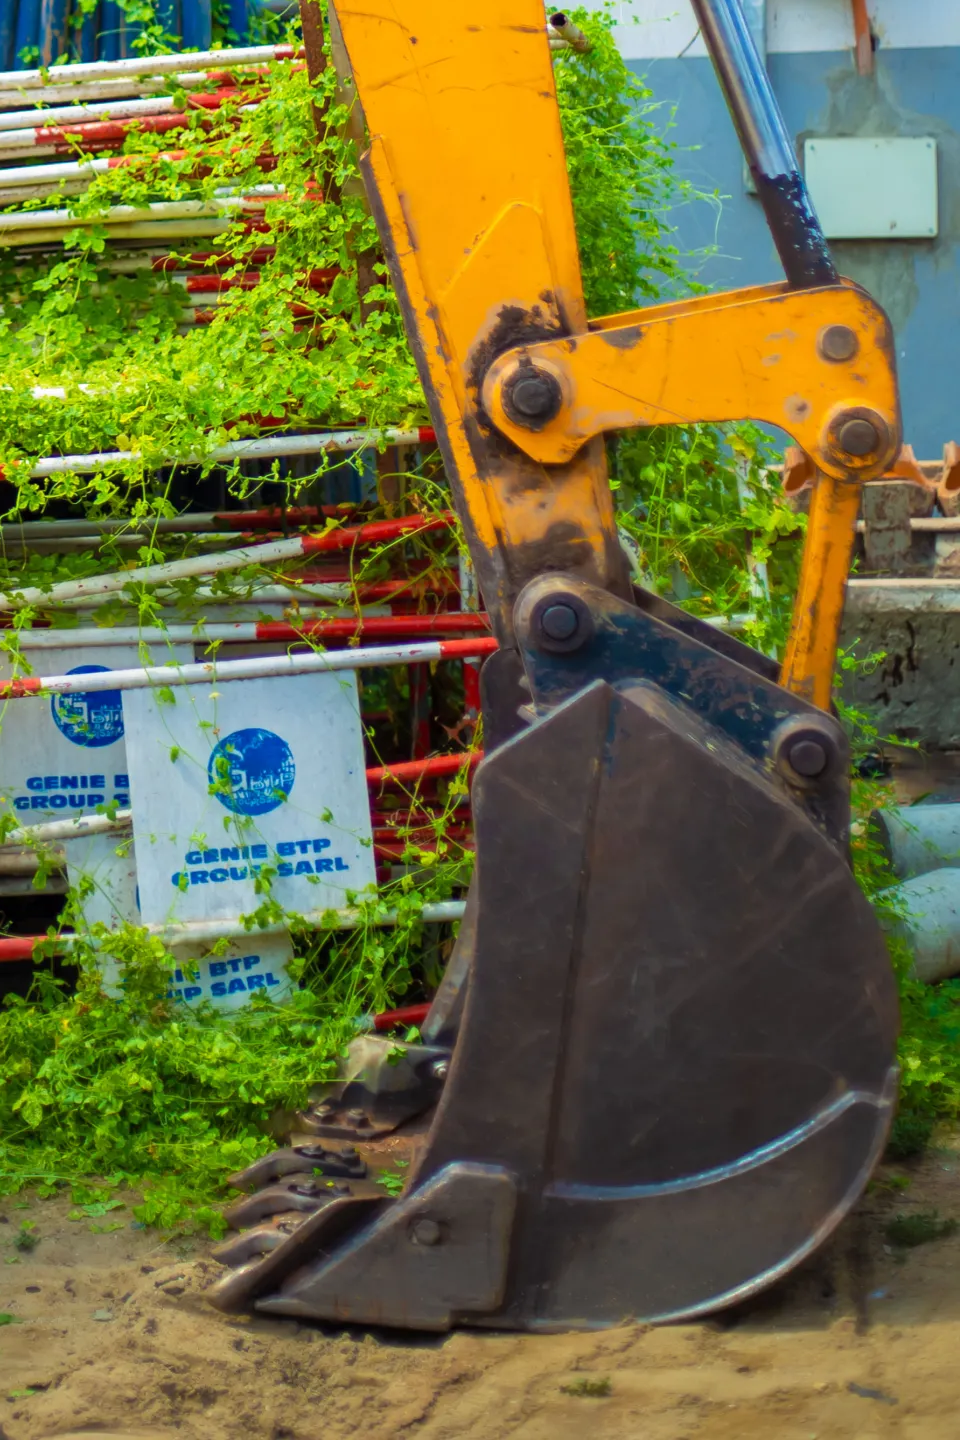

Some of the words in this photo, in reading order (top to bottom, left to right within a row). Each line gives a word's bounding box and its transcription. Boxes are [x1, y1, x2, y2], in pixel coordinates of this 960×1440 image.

[26, 774, 105, 790] GENIE
[13, 793, 105, 810] GROUP
[185, 844, 267, 865] GENIE
[276, 838, 331, 857] BTP
[276, 857, 349, 877] SARL
[209, 955, 261, 977] BTP
[210, 972, 280, 997] SARL
